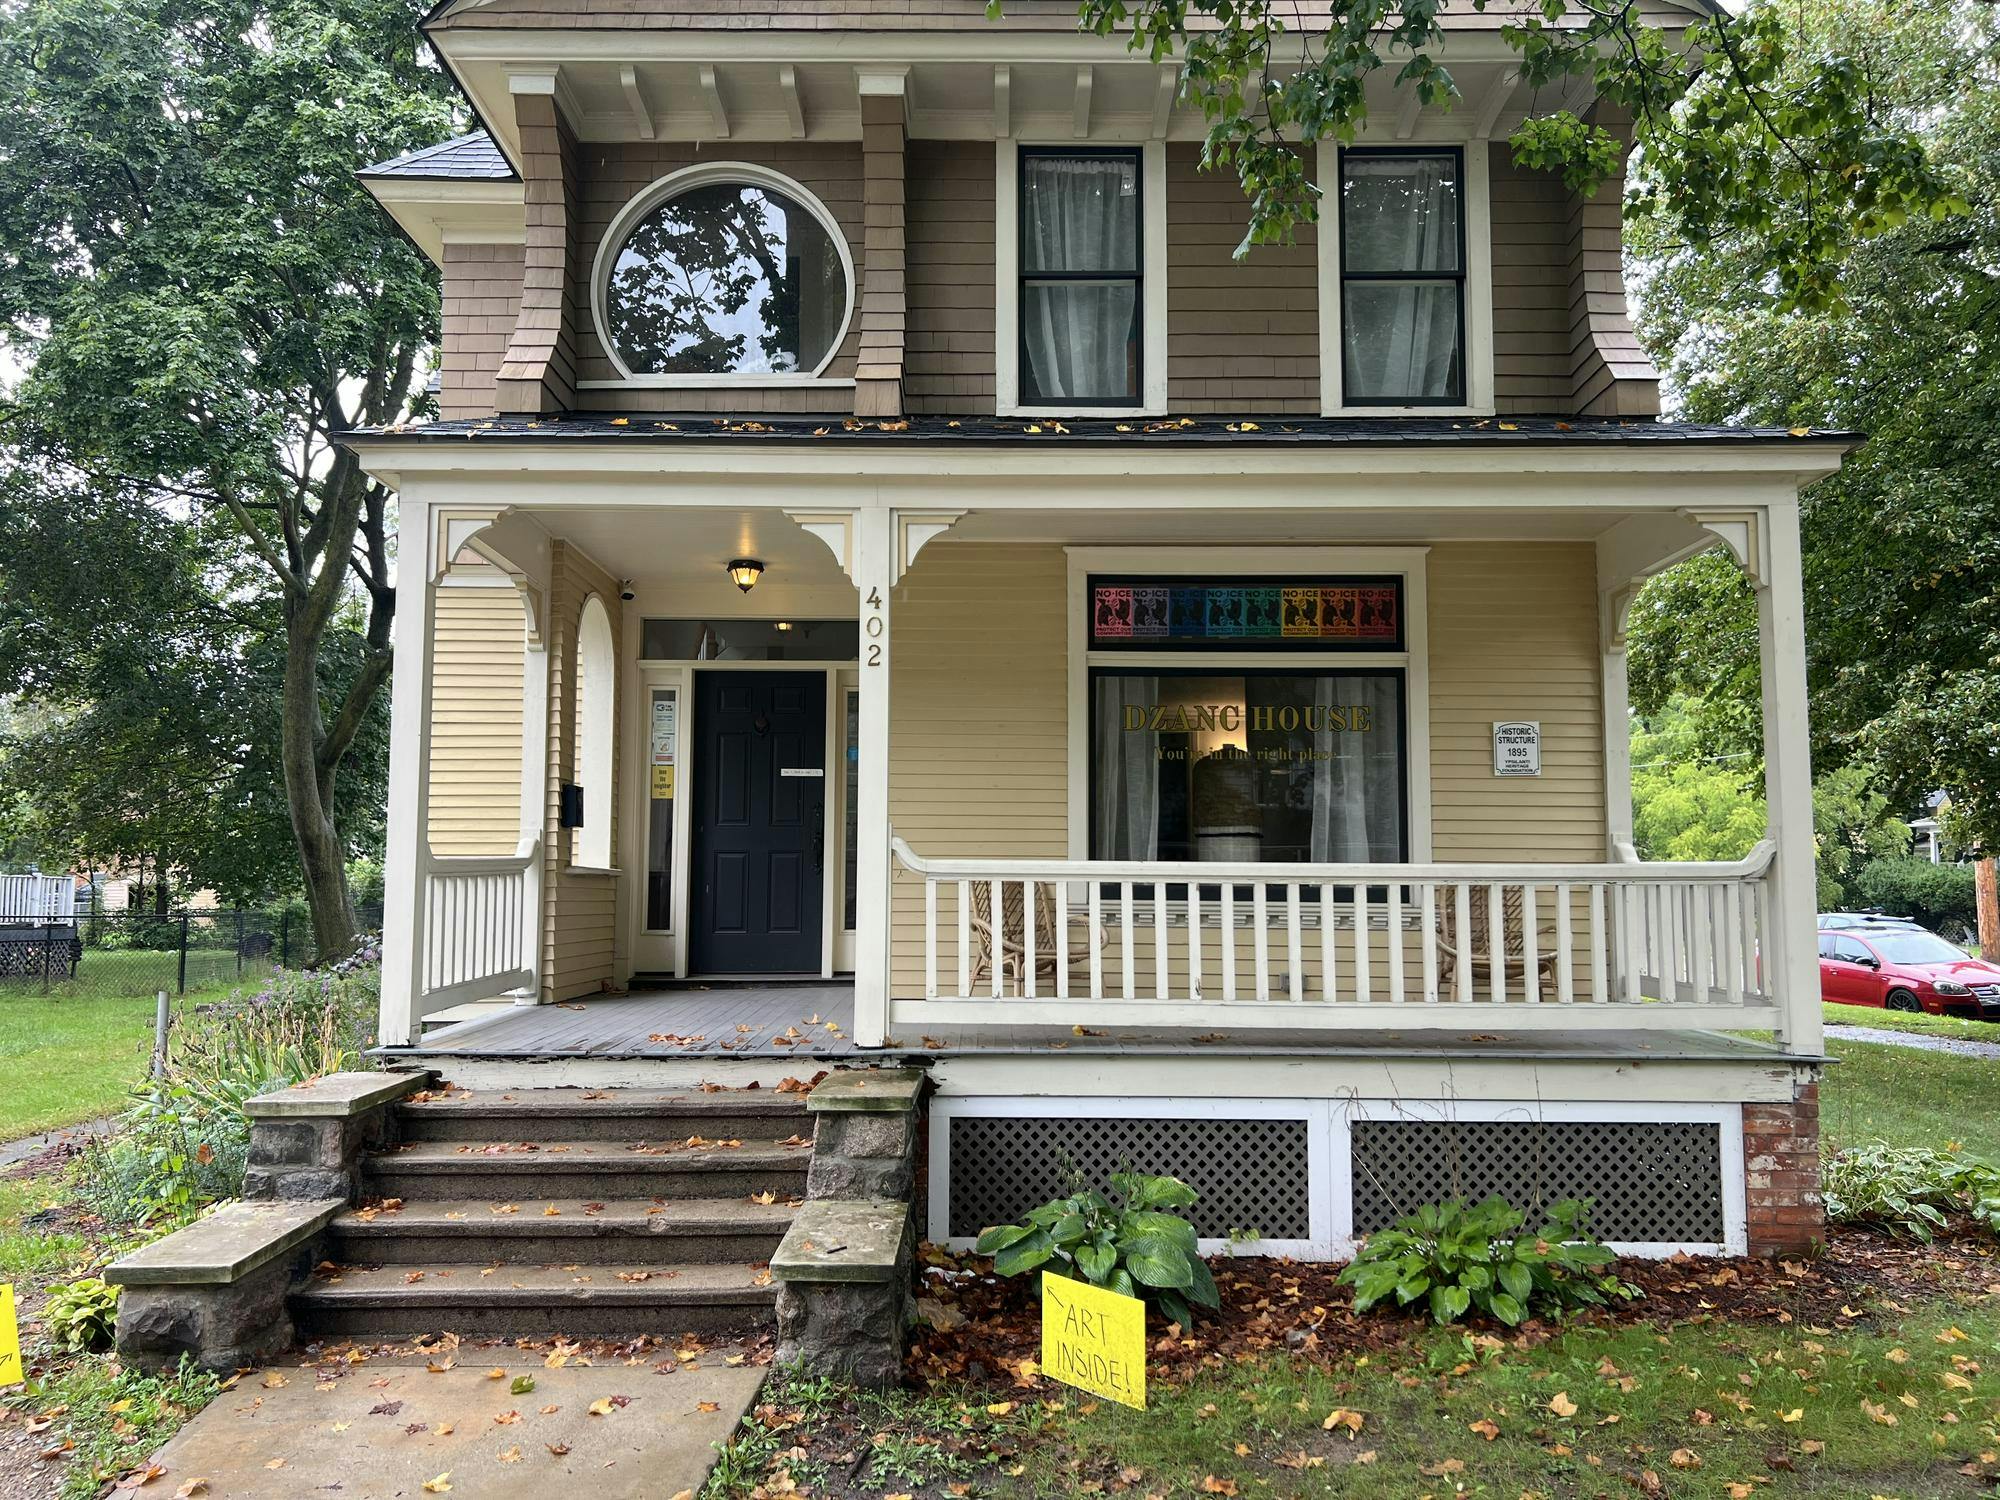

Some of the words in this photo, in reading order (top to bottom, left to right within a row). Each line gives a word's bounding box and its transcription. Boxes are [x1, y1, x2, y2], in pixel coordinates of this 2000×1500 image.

[1096, 590, 1111, 598] NO
[1115, 590, 1131, 598] ICE
[1283, 590, 1298, 598] NO
[1302, 590, 1318, 598] ICE
[865, 586, 883, 666] 402
[1122, 704, 1240, 732] DZANC
[1250, 704, 1371, 732] HOUSE
[1501, 727, 1531, 735] HISTORIC
[1498, 736, 1535, 744] STRUCTURE
[1209, 747, 1223, 760] in
[1256, 746, 1293, 761] right
[1507, 747, 1527, 757] 1895
[1065, 1304, 1111, 1346] ART
[1057, 1340, 1131, 1394] INSIDE!
